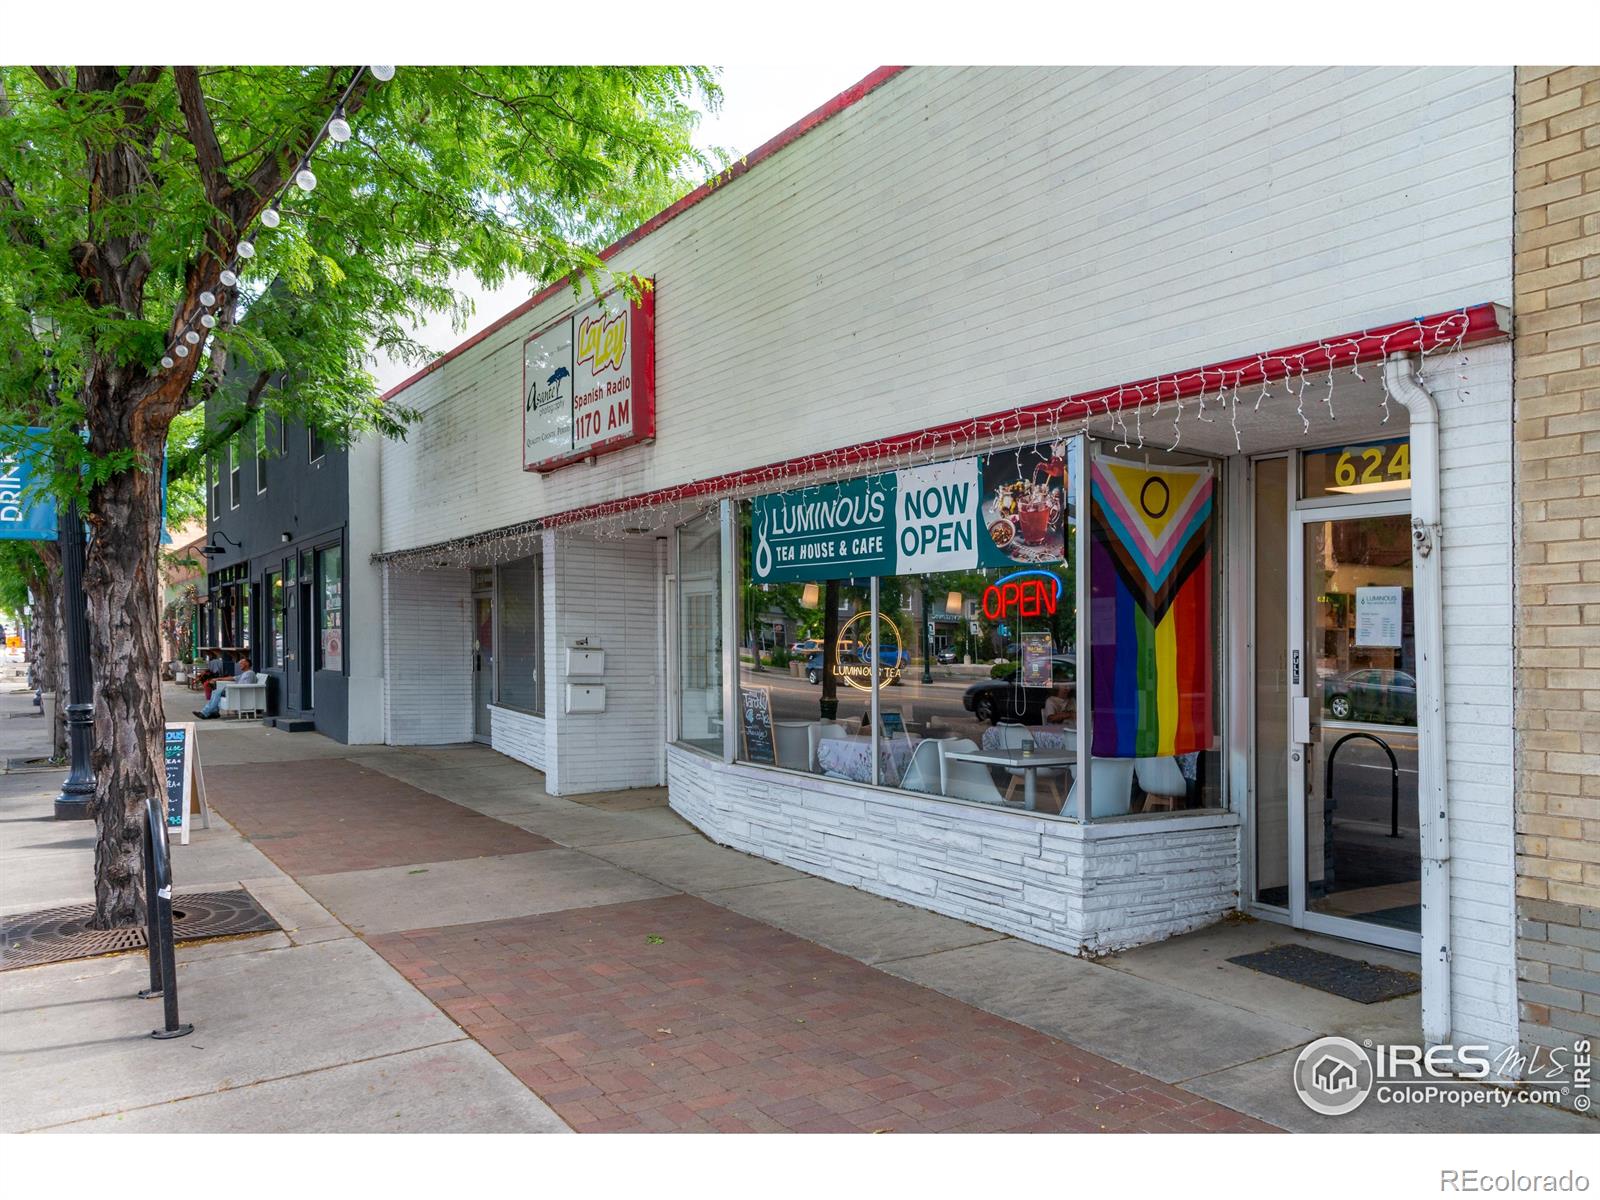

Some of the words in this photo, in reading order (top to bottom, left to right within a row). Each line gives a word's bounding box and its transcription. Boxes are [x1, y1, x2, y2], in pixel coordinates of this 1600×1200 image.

[574, 386, 604, 411] Spanish
[606, 375, 631, 396] Radio
[576, 409, 601, 440] 1170
[607, 398, 630, 431] AM
[1335, 443, 1410, 486] 624
[771, 491, 885, 535] LUMINOUS
[904, 482, 969, 521] NOW
[776, 546, 795, 562] TEA
[800, 541, 835, 560] HOUSE
[839, 540, 848, 556] &
[852, 535, 884, 555] CAFE
[900, 519, 973, 557] OPEN
[982, 578, 1057, 620] OPEN
[884, 667, 902, 678] TEA
